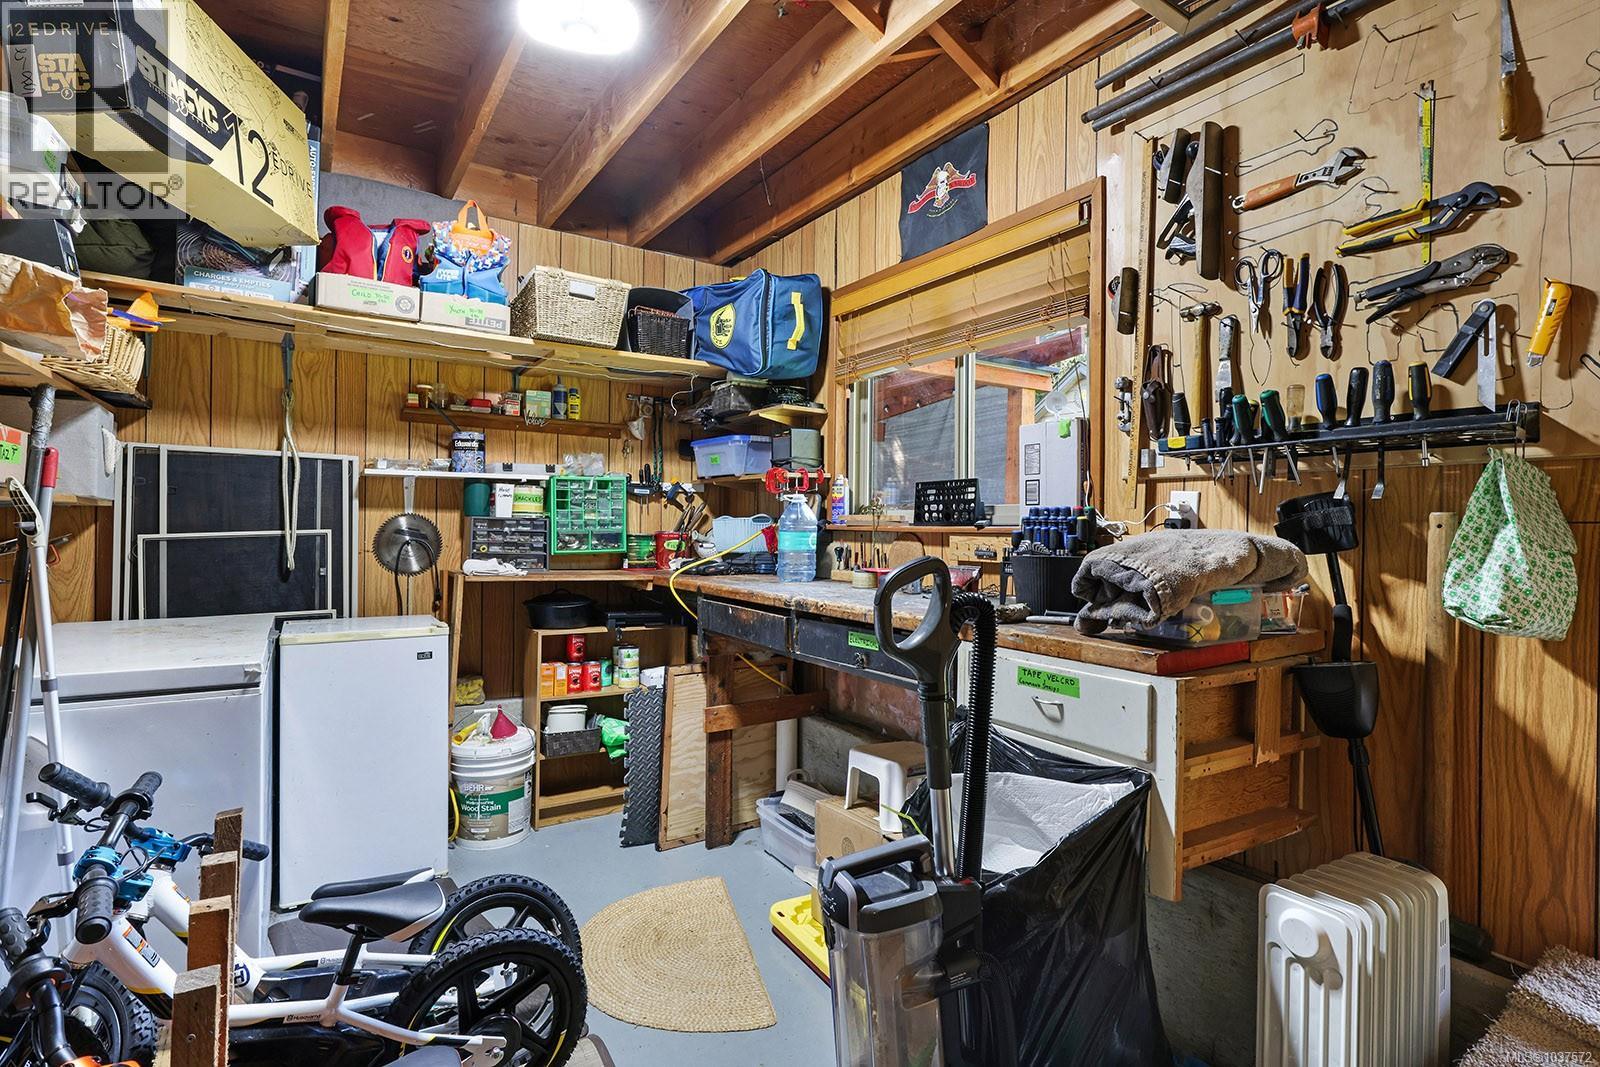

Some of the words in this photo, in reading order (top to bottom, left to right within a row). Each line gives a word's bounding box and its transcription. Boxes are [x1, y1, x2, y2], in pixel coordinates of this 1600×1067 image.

[37, 53, 85, 72] STA
[40, 71, 91, 93] CYC
[223, 112, 274, 207] 12
[1046, 673, 1076, 686] VELCRO
[461, 804, 479, 812] Wood
[481, 804, 502, 812] Stain
